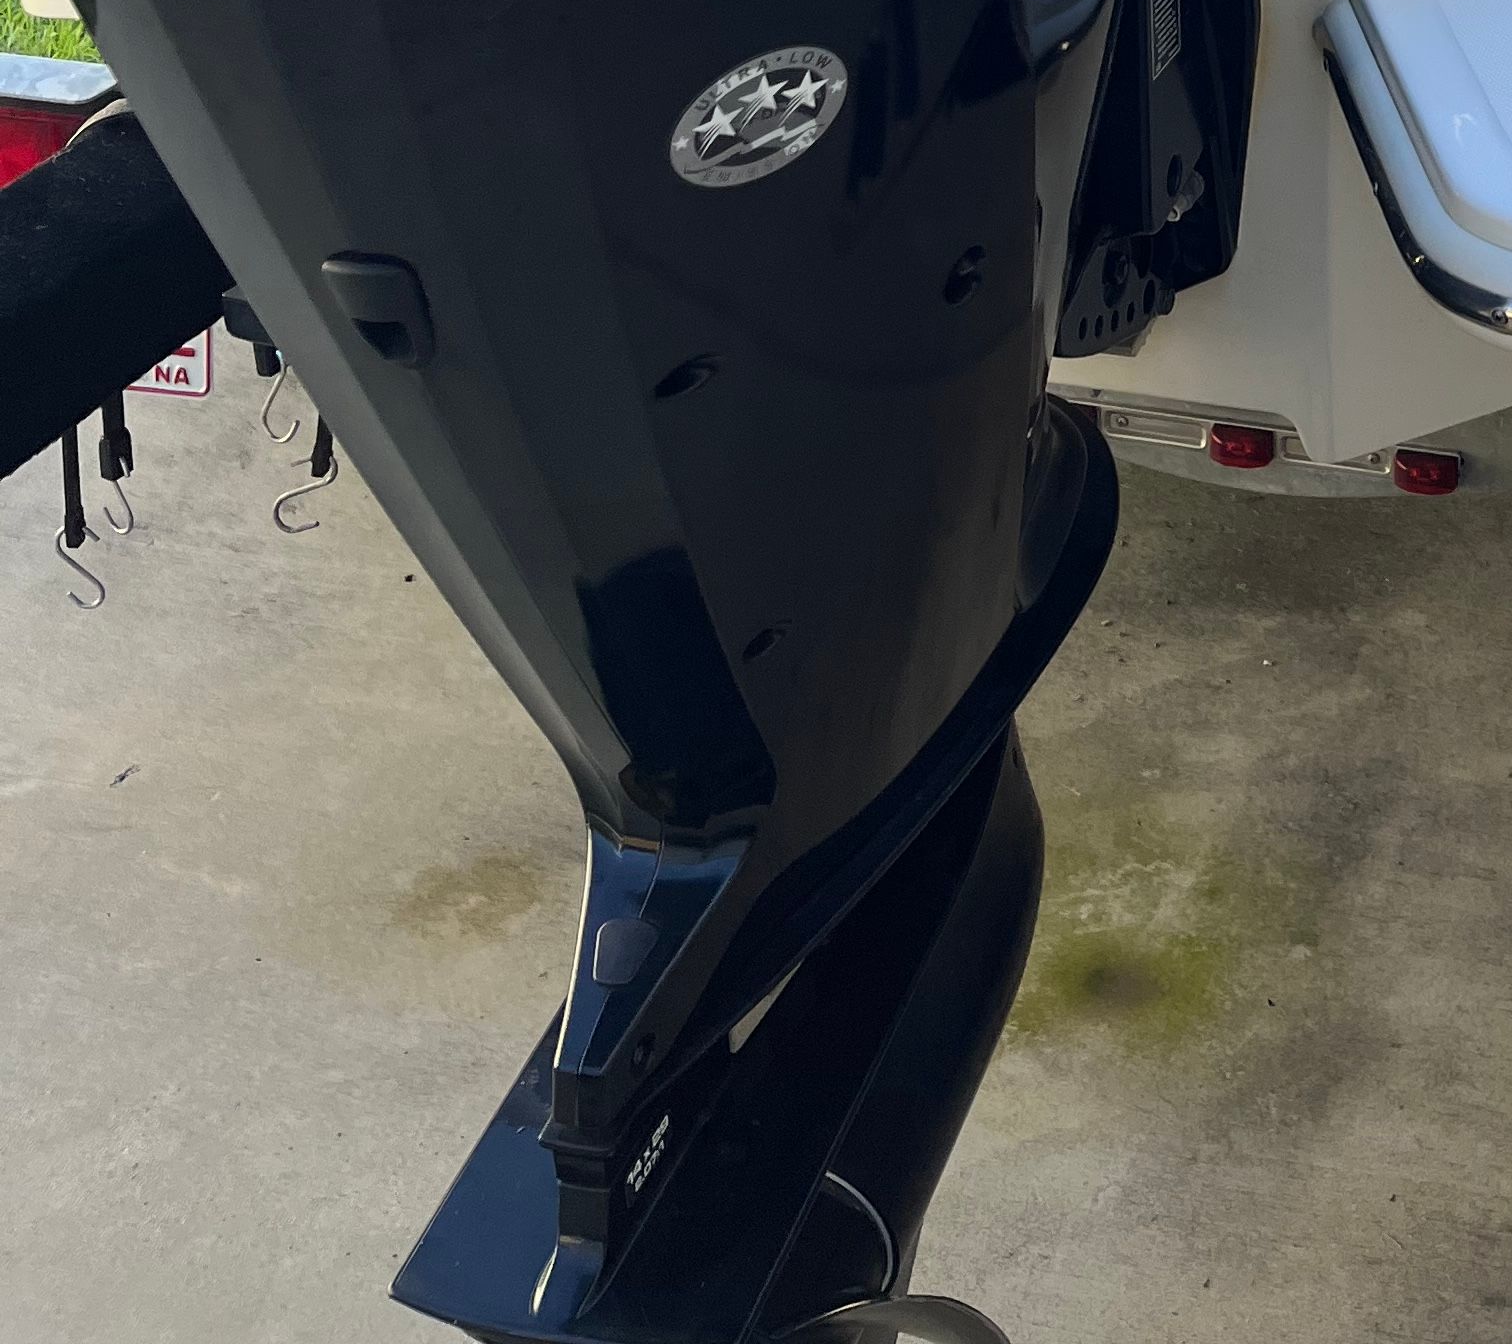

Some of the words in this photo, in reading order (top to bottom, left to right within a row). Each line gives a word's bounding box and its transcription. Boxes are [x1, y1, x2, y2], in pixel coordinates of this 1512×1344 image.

[694, 58, 770, 112] ULTRA
[789, 50, 833, 69] LOW
[154, 364, 190, 385] NA
